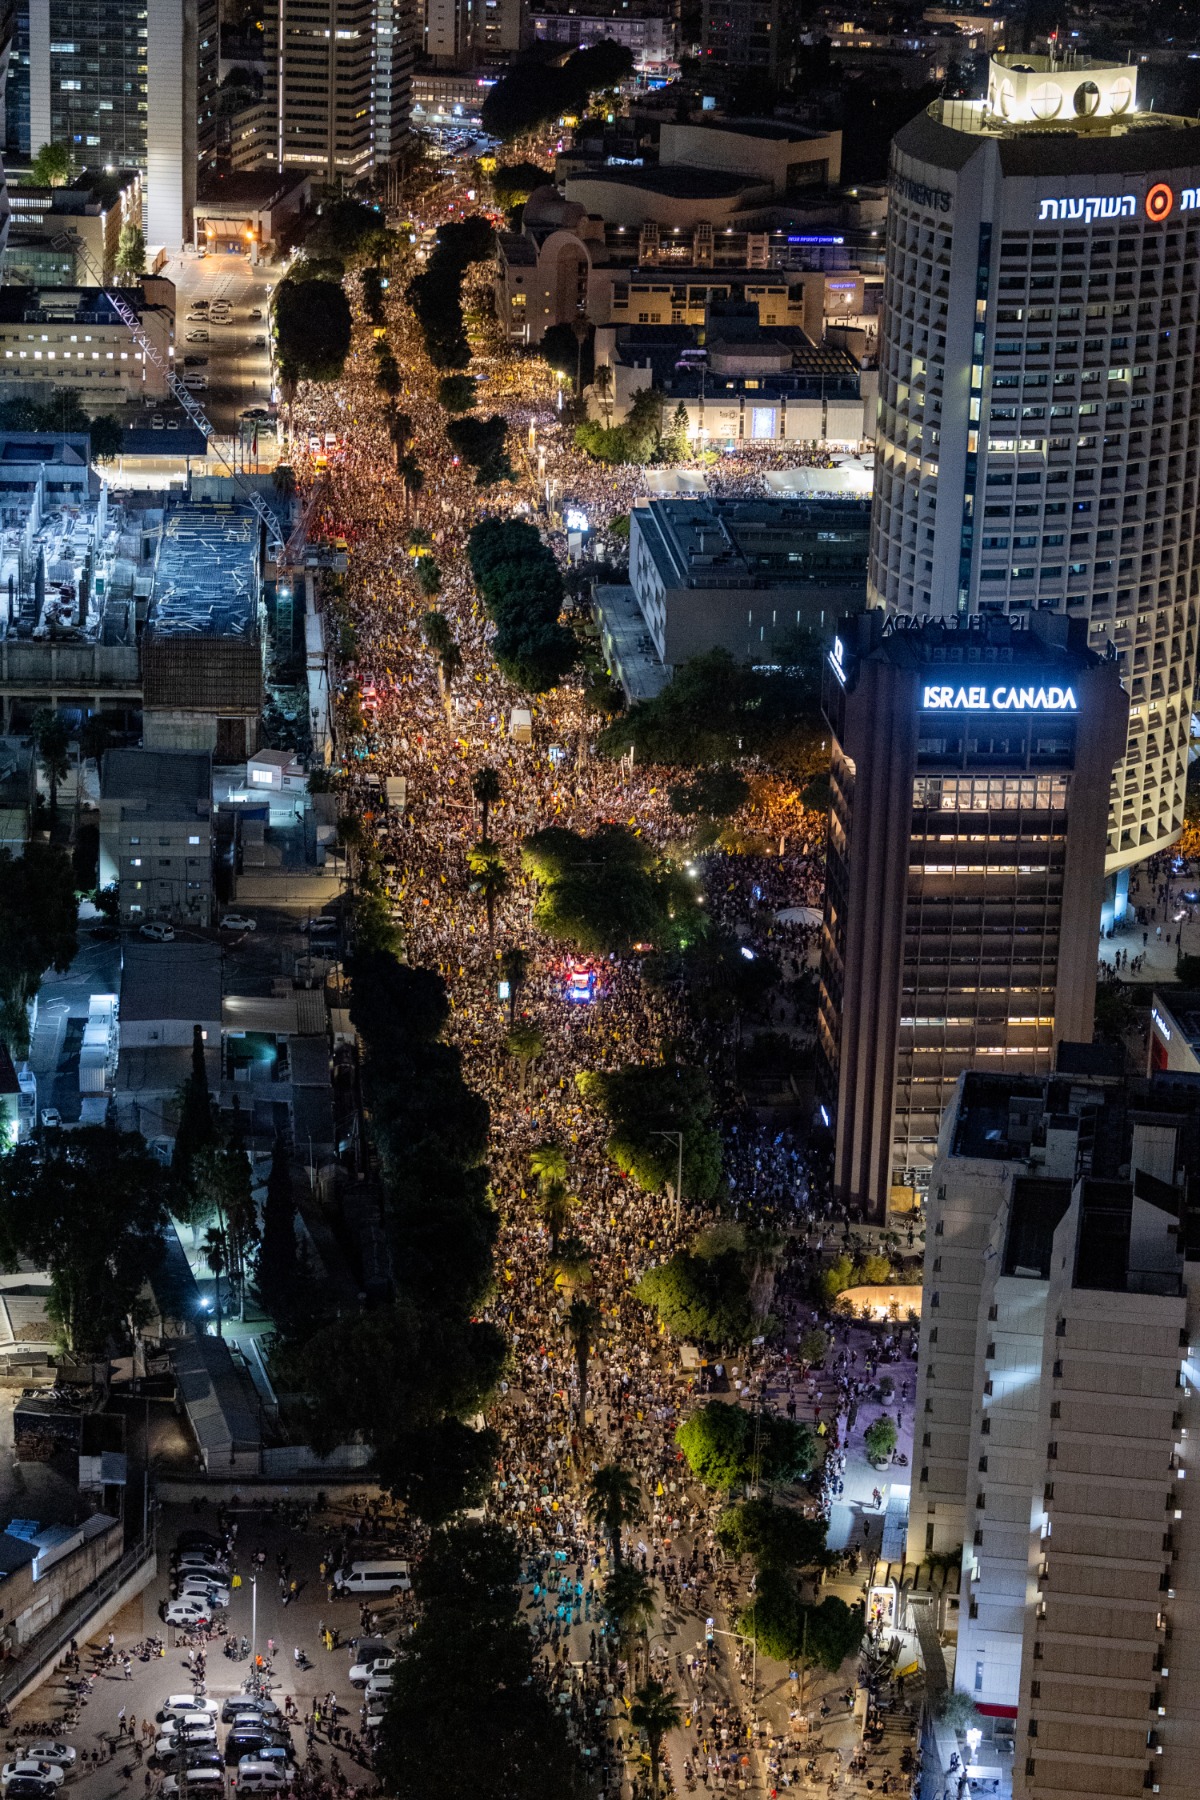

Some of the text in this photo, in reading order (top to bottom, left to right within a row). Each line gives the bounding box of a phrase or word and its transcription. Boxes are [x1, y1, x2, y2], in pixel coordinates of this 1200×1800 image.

[1039, 195, 1136, 224] השקעות
[923, 686, 1077, 708] ISRAEL CANADA
